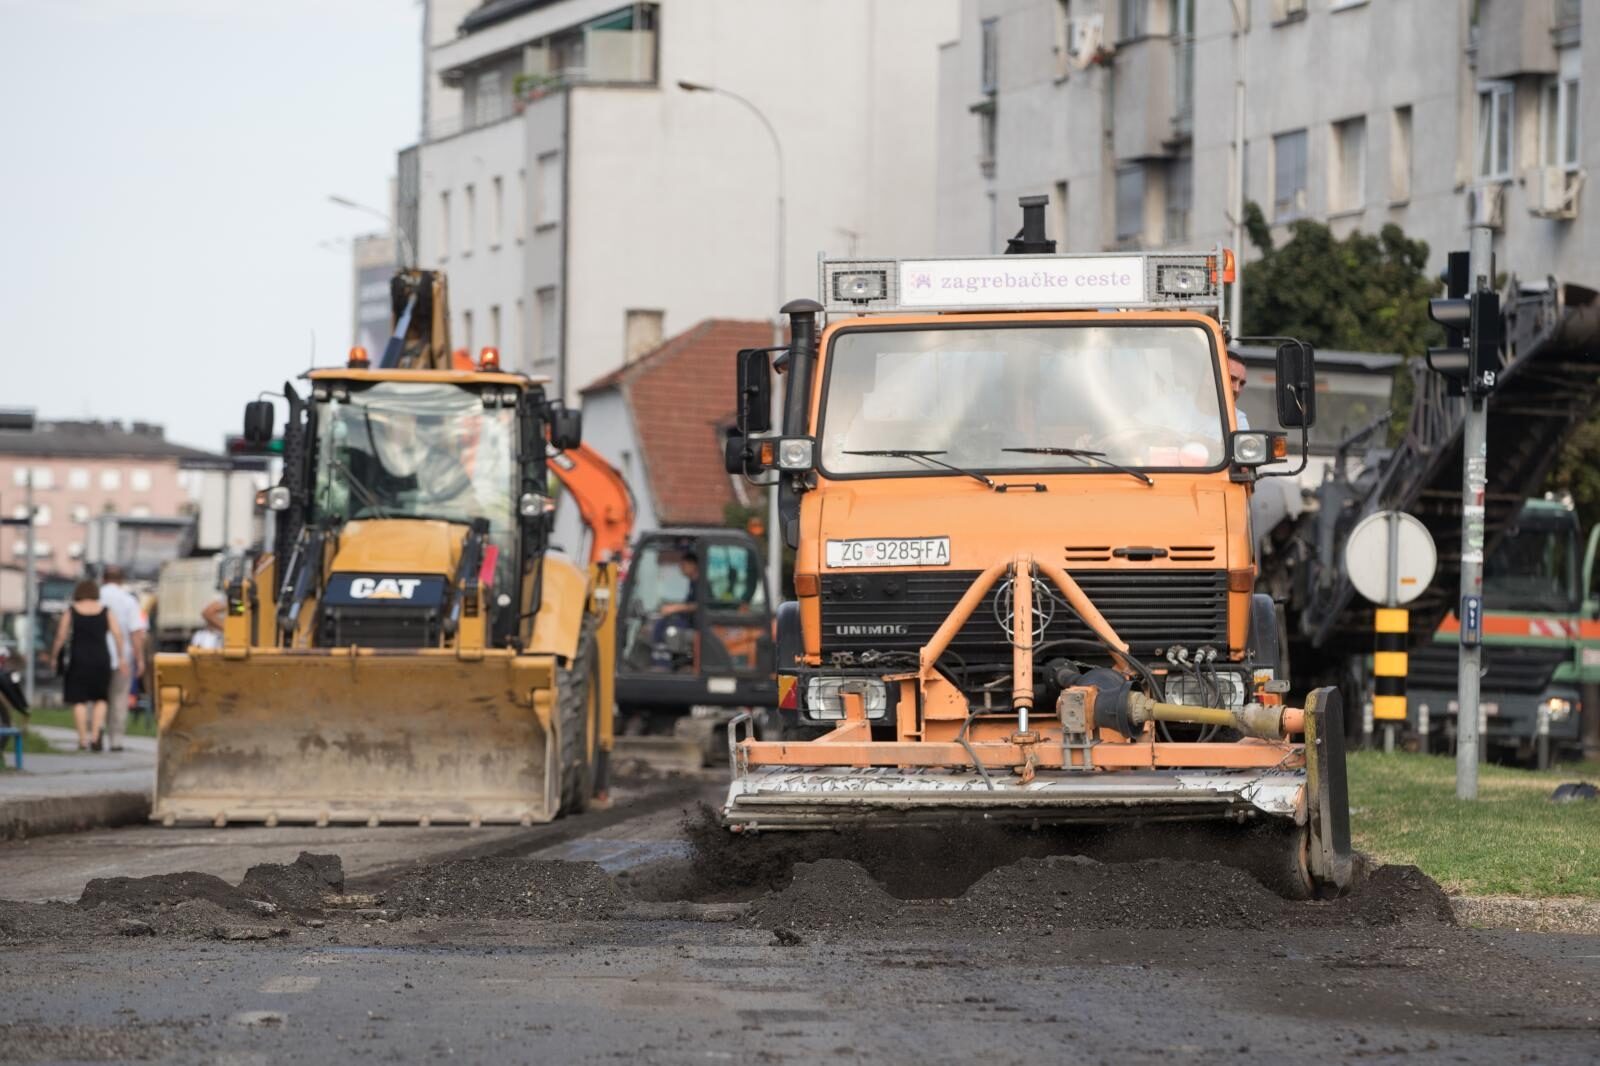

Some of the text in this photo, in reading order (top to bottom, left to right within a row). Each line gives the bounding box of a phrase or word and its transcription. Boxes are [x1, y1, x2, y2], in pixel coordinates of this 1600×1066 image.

[941, 272, 1131, 292] zagrebačke ceste
[841, 543, 863, 561] ZG
[349, 578, 421, 599] CAT
[836, 625, 907, 635] UNIMOG
